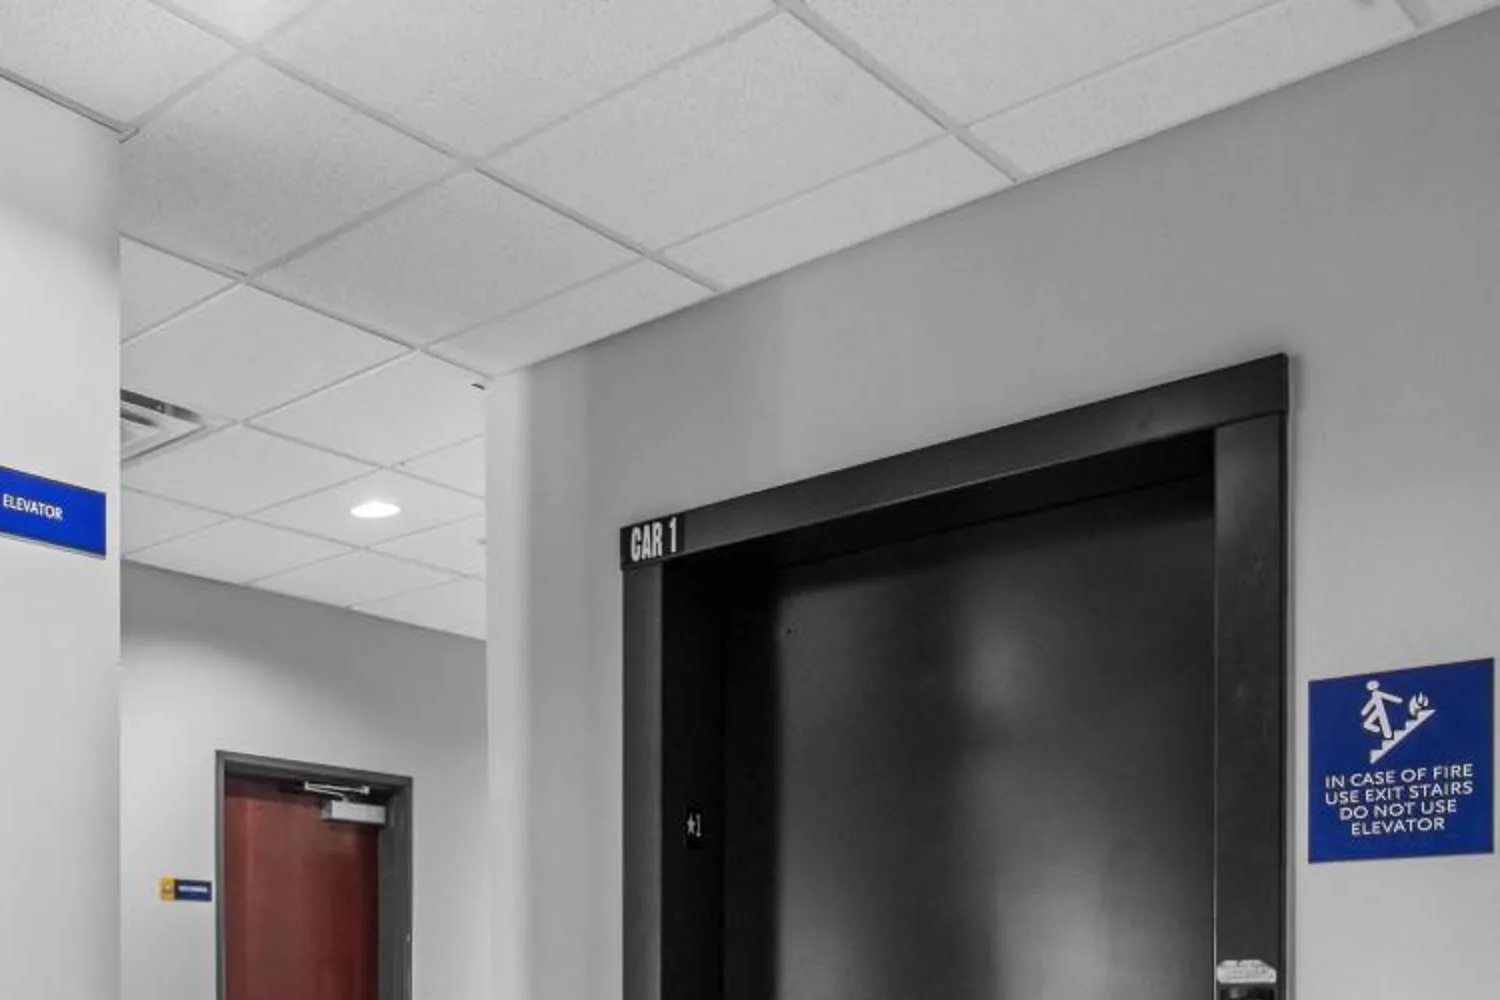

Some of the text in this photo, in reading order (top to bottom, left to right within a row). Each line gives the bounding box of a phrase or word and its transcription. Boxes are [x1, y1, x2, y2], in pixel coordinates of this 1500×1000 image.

[3, 493, 64, 521] ELEVATOR
[630, 516, 677, 562] CAR 1
[1325, 763, 1473, 789] IN CASE OF FIRE
[1325, 780, 1473, 805] USE EXIT STAIRS
[1339, 798, 1457, 821] DO NOT USE
[1351, 817, 1445, 836] ELEVATOR
